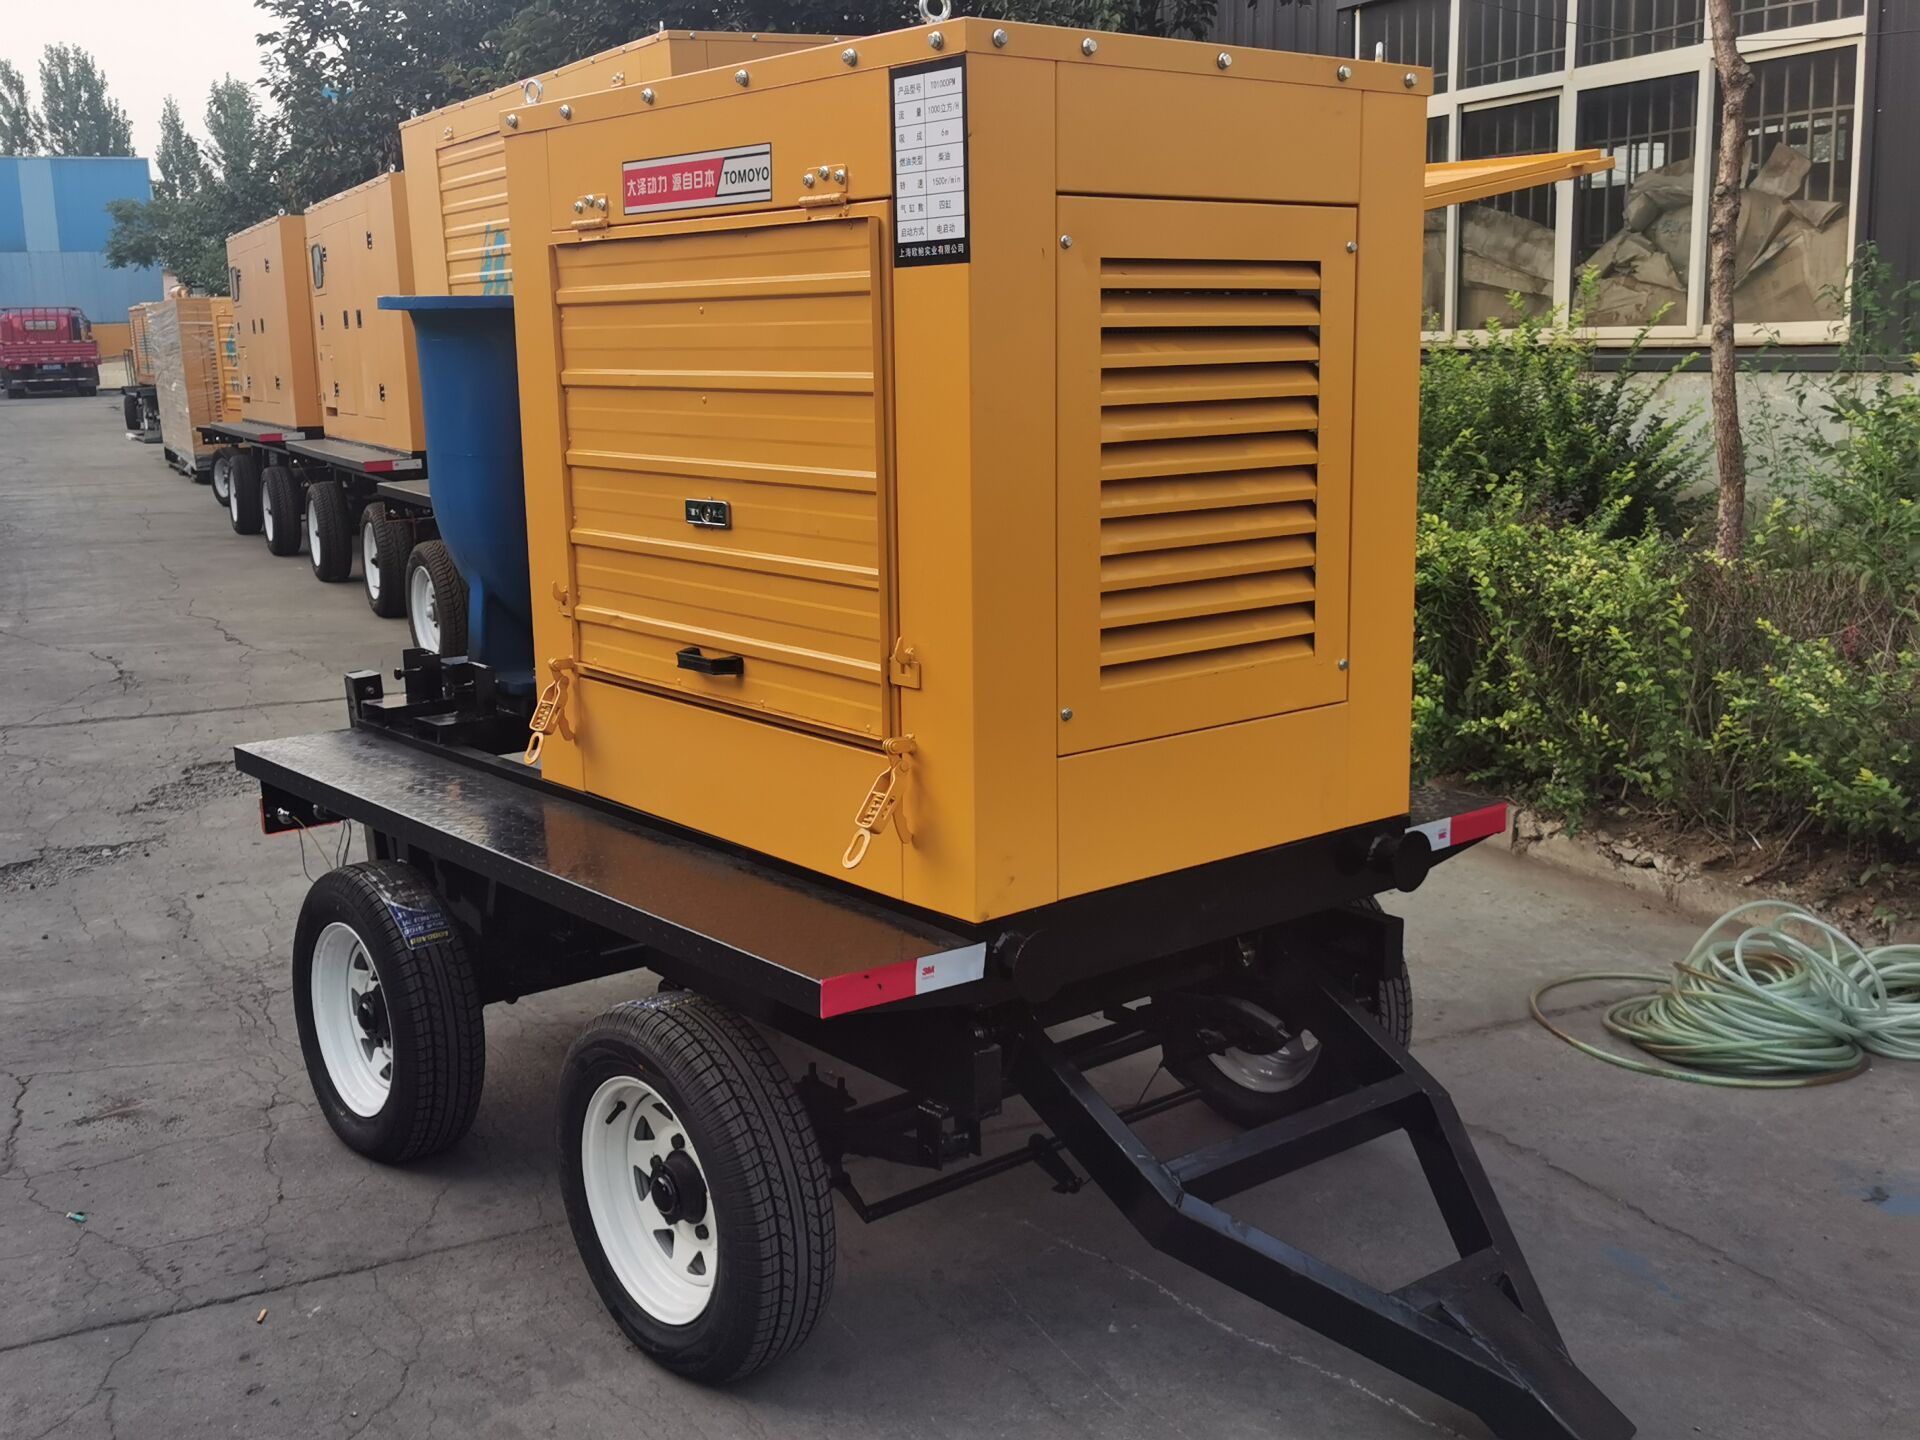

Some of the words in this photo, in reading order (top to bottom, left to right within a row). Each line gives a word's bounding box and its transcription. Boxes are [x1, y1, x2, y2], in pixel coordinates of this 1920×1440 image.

[626, 176, 668, 197] 大泽动力
[672, 169, 715, 190] 源自日本
[723, 166, 770, 185] TOMOYO
[901, 226, 925, 238] 启动方式
[936, 223, 956, 235] 电启动
[922, 966, 935, 975] 3M
